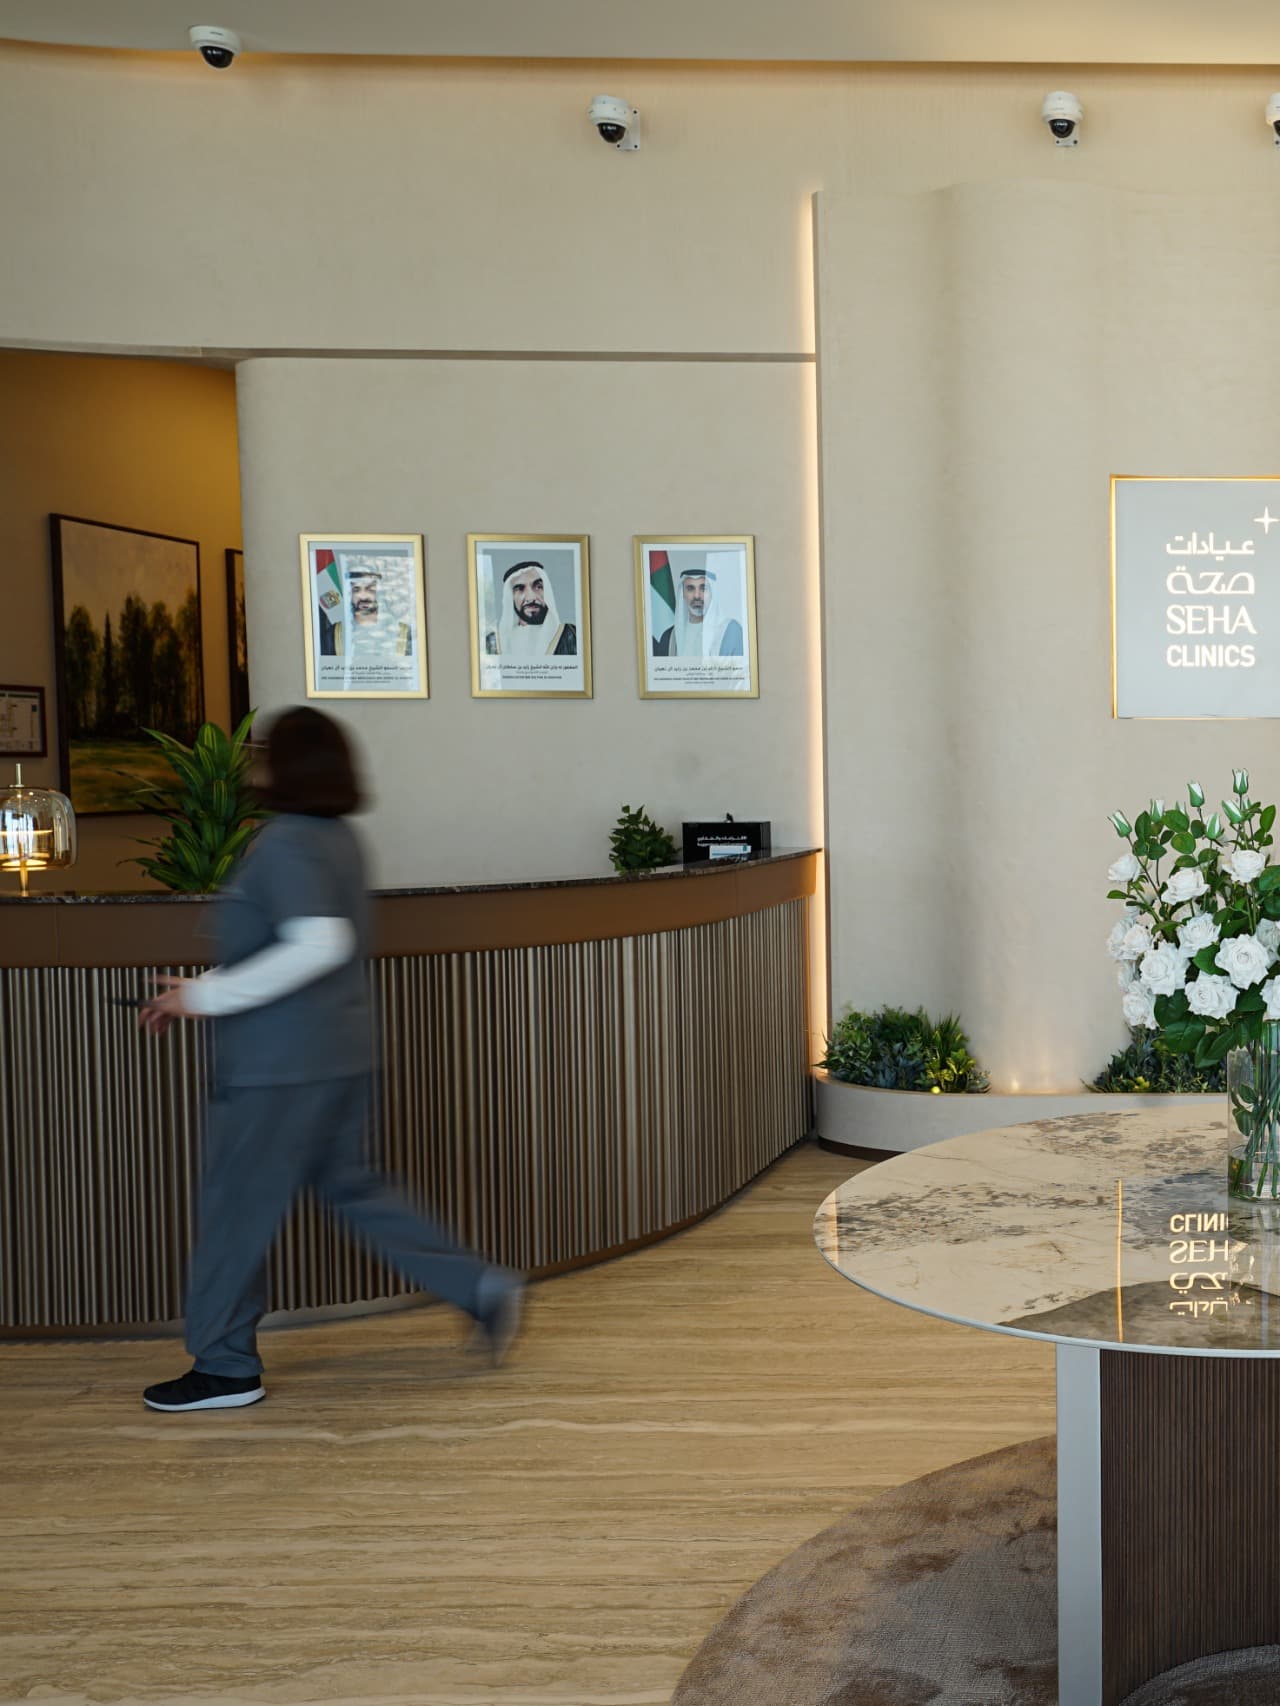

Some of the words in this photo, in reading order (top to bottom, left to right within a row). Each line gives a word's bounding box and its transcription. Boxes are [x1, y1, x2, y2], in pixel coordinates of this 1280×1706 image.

[1165, 532, 1255, 560] عيادات
[1166, 566, 1255, 594] صحة
[1166, 604, 1257, 634] SEHA
[1166, 644, 1256, 668] CLINICS
